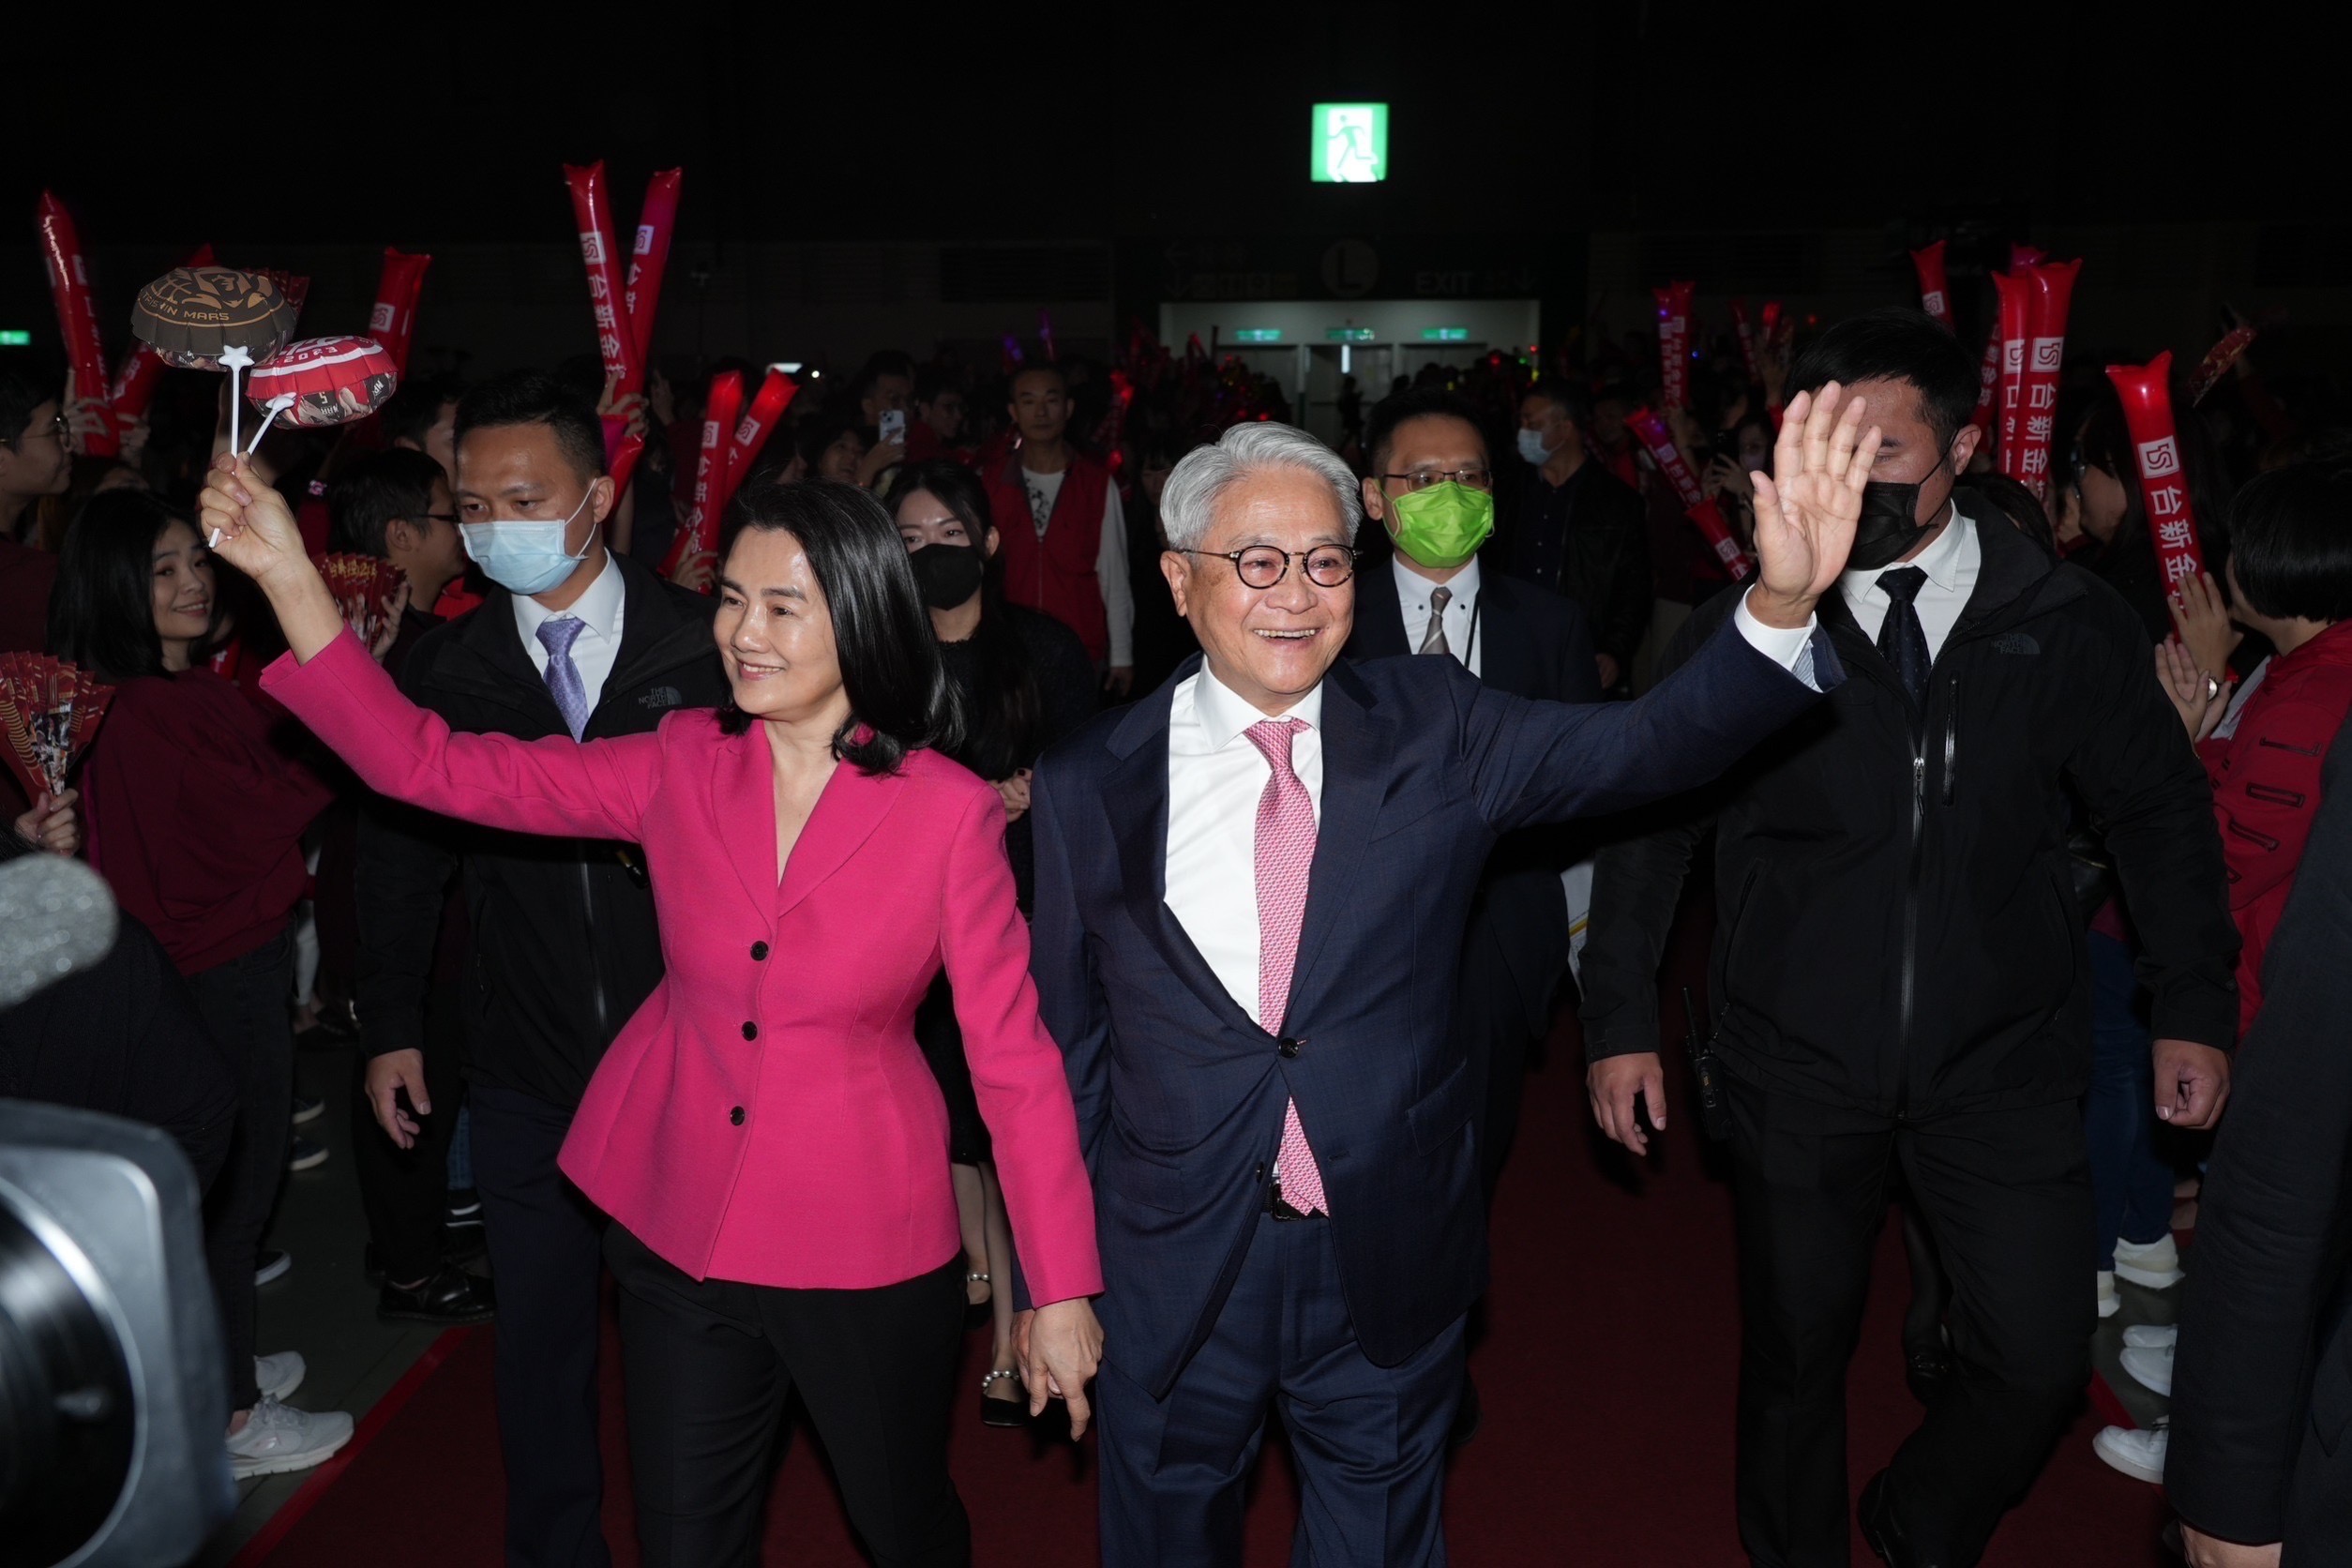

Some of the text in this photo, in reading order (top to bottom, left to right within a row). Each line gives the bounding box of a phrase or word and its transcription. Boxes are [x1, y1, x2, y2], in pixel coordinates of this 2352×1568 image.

[1414, 270, 1473, 294] EXIT
[184, 310, 230, 321] MARS
[2150, 484, 2198, 610] 台新金
